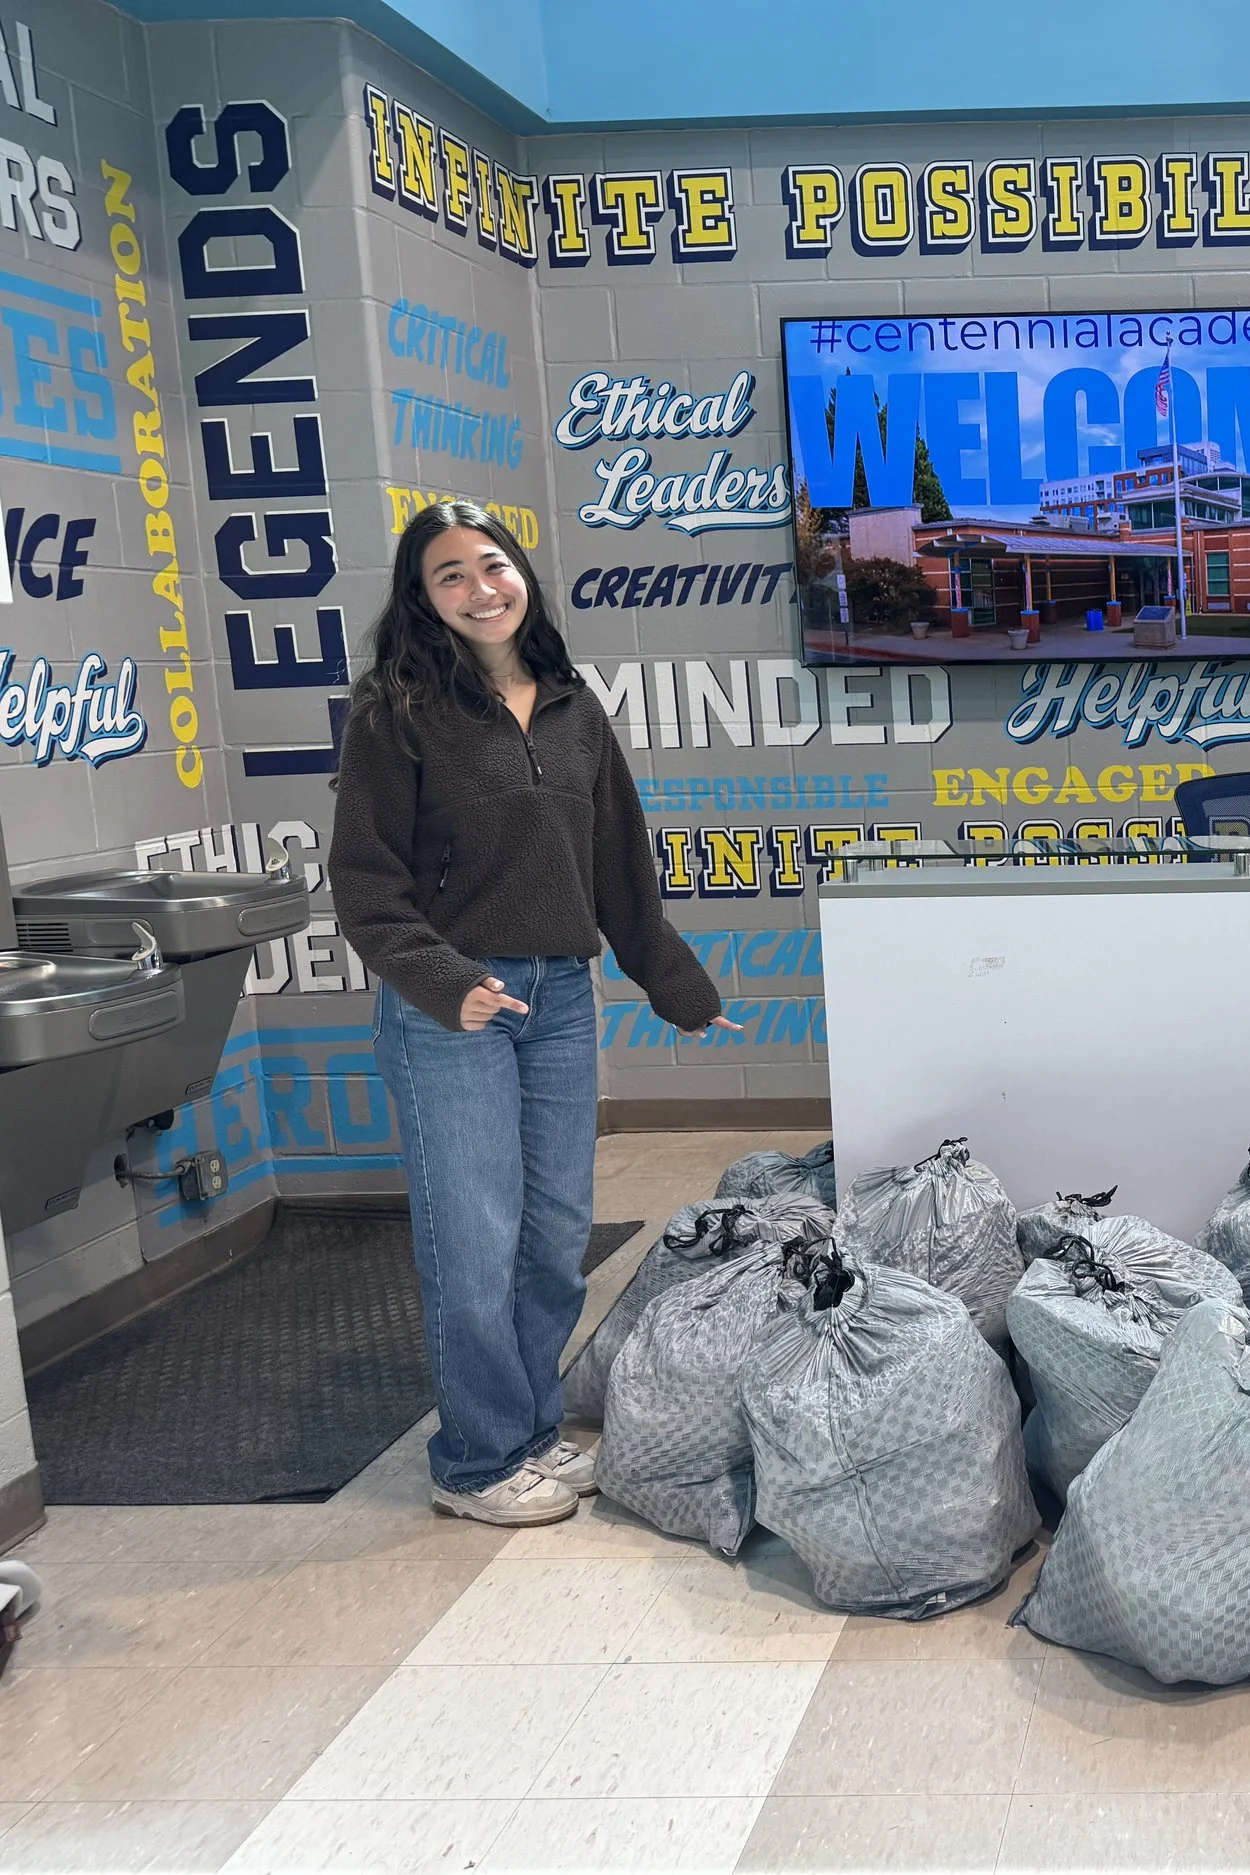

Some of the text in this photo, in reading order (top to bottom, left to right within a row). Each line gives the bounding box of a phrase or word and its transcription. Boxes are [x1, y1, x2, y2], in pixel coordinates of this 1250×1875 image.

[365, 82, 738, 268] INFINITE
[388, 296, 510, 390] CRITICAL
[165, 99, 351, 777] LEGENDS
[391, 387, 524, 471] THINKING
[556, 370, 756, 450] Ethical
[101, 158, 203, 789] COLLABORATION
[578, 446, 793, 538] Leaders
[571, 562, 799, 610] CREATIVIT
[636, 774, 889, 812] ESPONSIBLE
